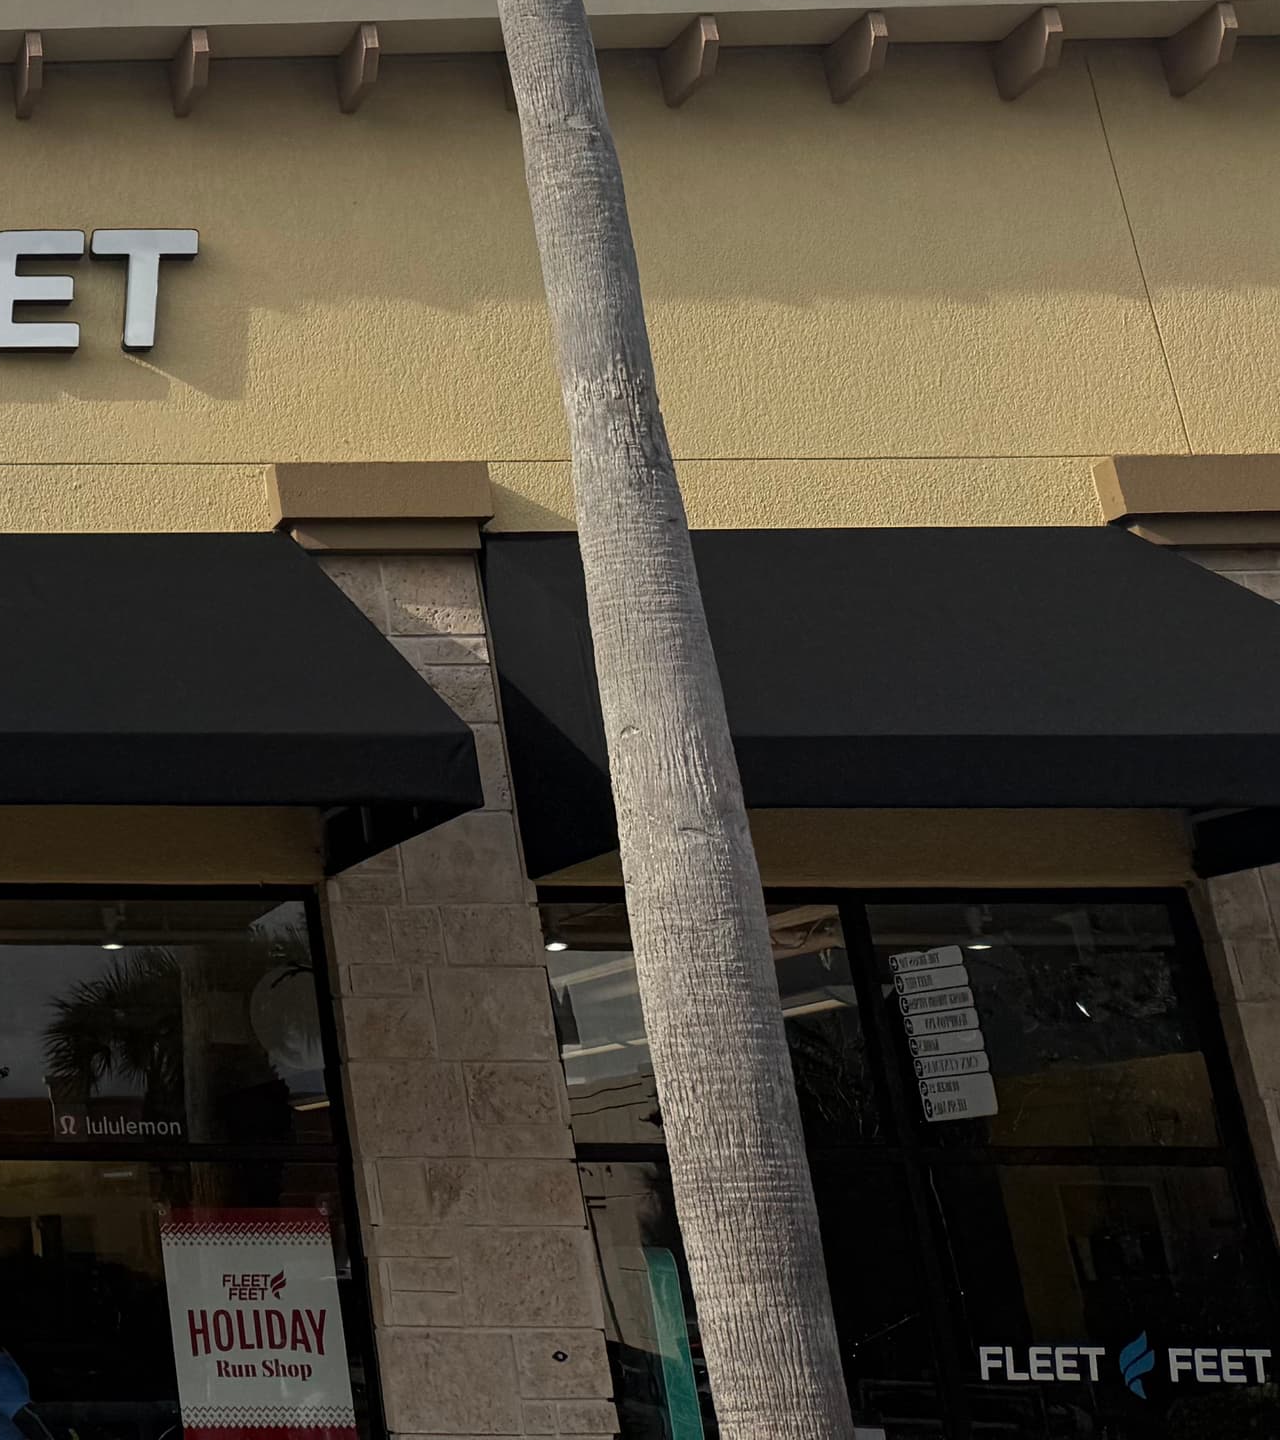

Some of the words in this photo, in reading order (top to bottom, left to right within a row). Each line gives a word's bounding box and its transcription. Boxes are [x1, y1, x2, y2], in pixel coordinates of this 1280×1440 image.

[86, 1116, 182, 1136] lululemon
[223, 1273, 271, 1288] FLEET
[229, 1288, 269, 1301] FEET
[187, 1309, 327, 1356] HOLIDAY
[217, 1360, 257, 1378] Run
[262, 1359, 313, 1381] Shop
[978, 1346, 1106, 1382] FLEET
[1168, 1348, 1272, 1384] FEET
